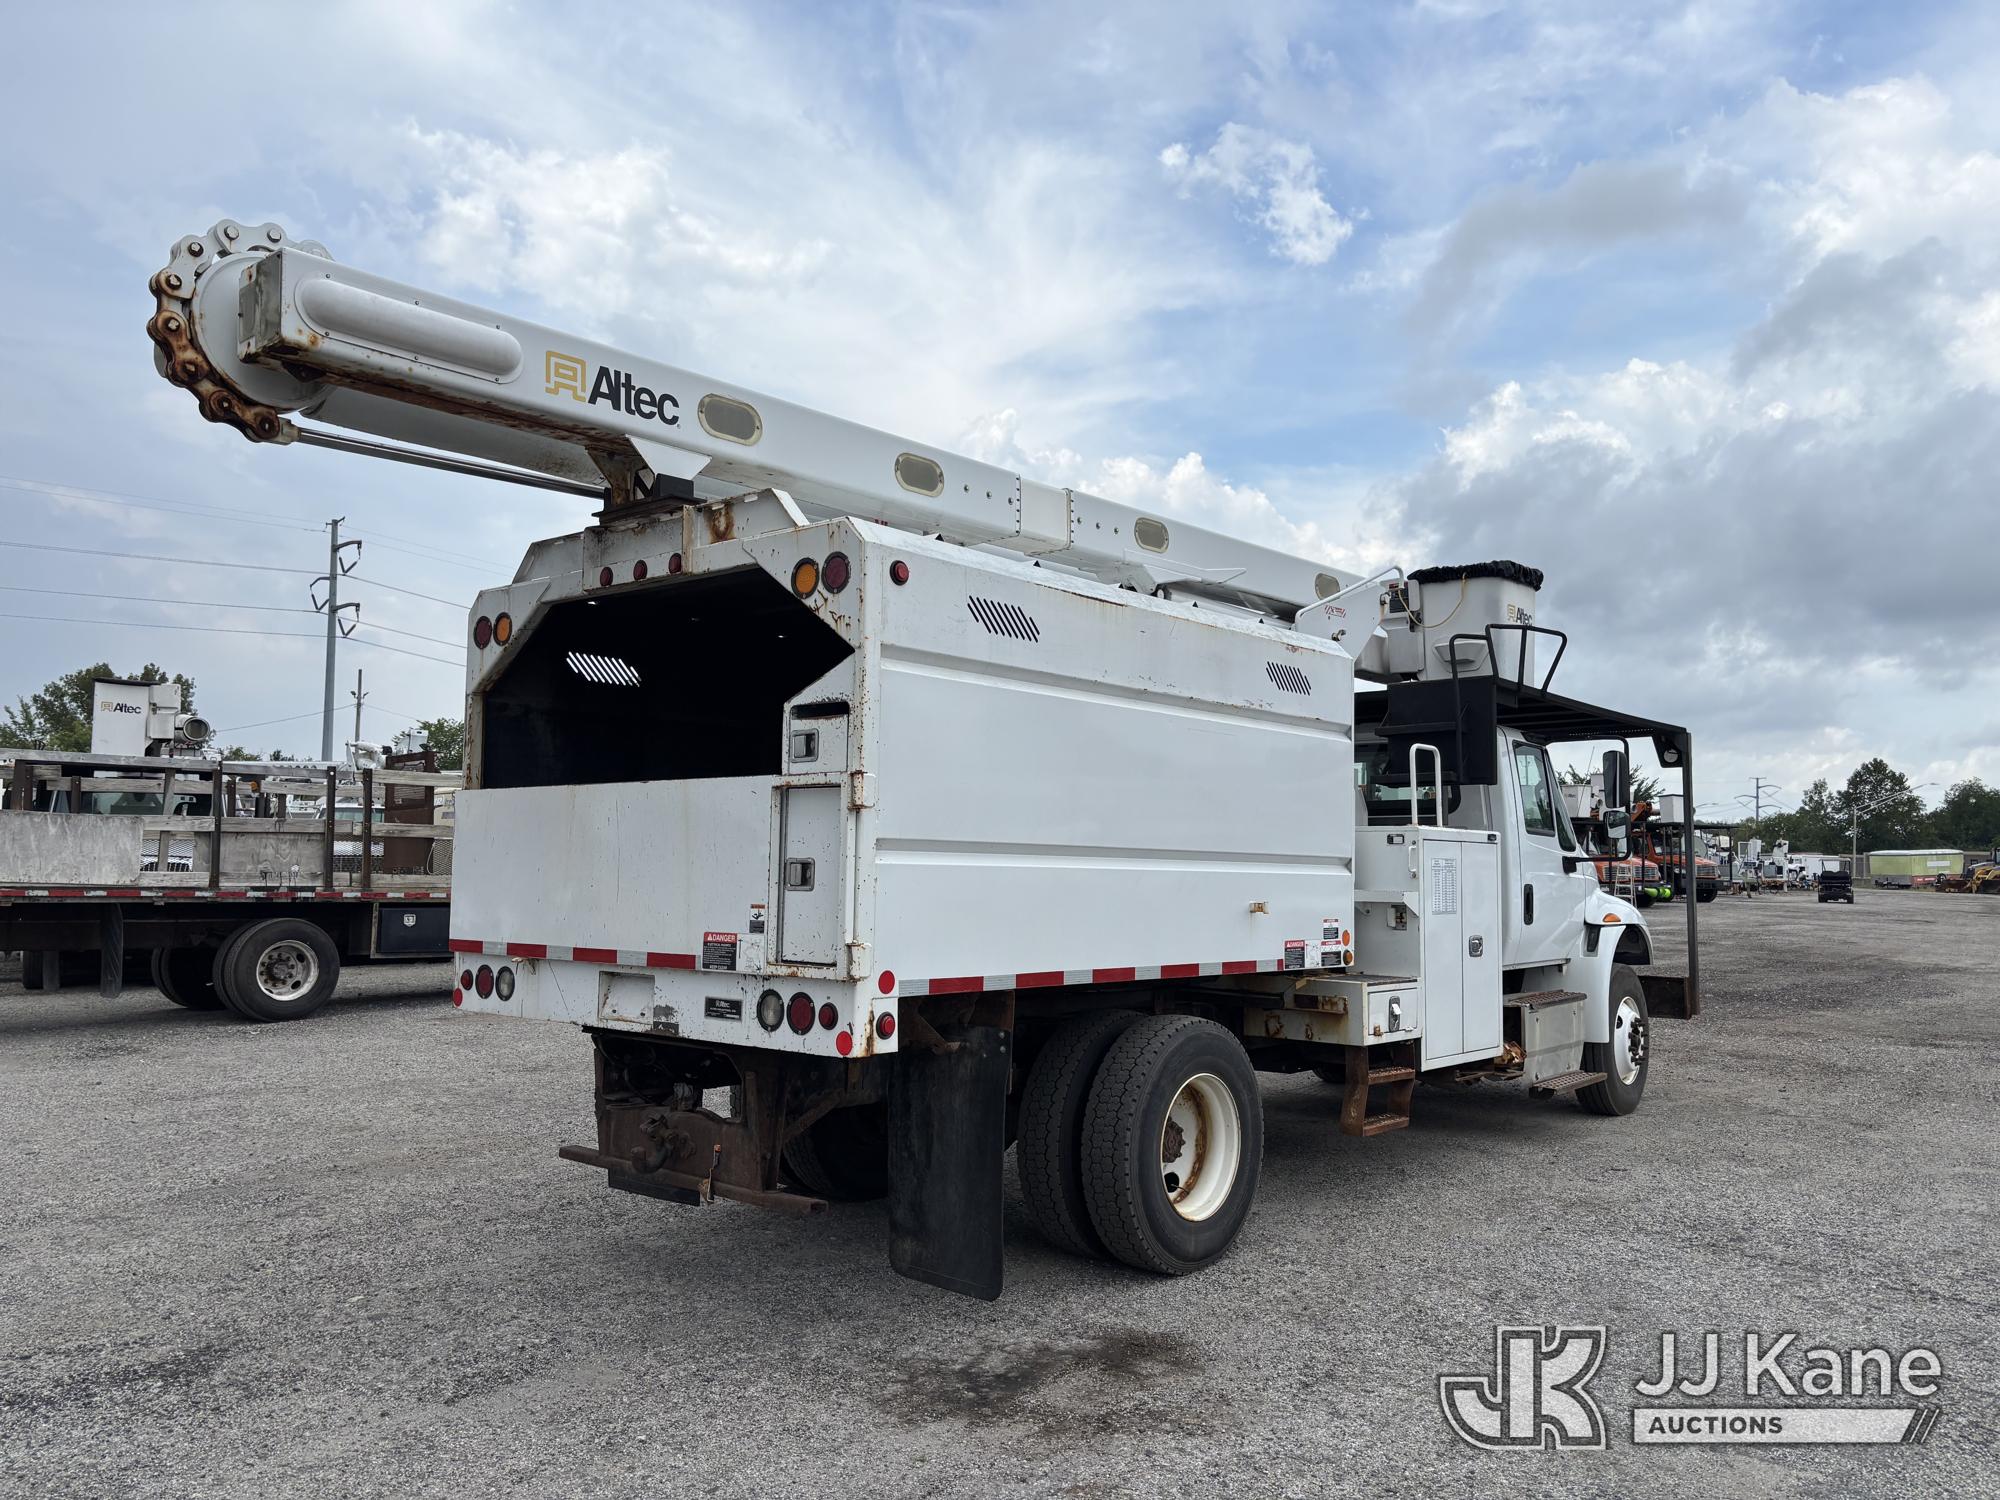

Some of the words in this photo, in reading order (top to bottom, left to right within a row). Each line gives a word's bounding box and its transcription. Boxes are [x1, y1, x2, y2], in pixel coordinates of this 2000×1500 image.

[588, 365, 680, 426] Altec
[113, 702, 142, 714] Altec
[712, 934, 736, 942] DANGER
